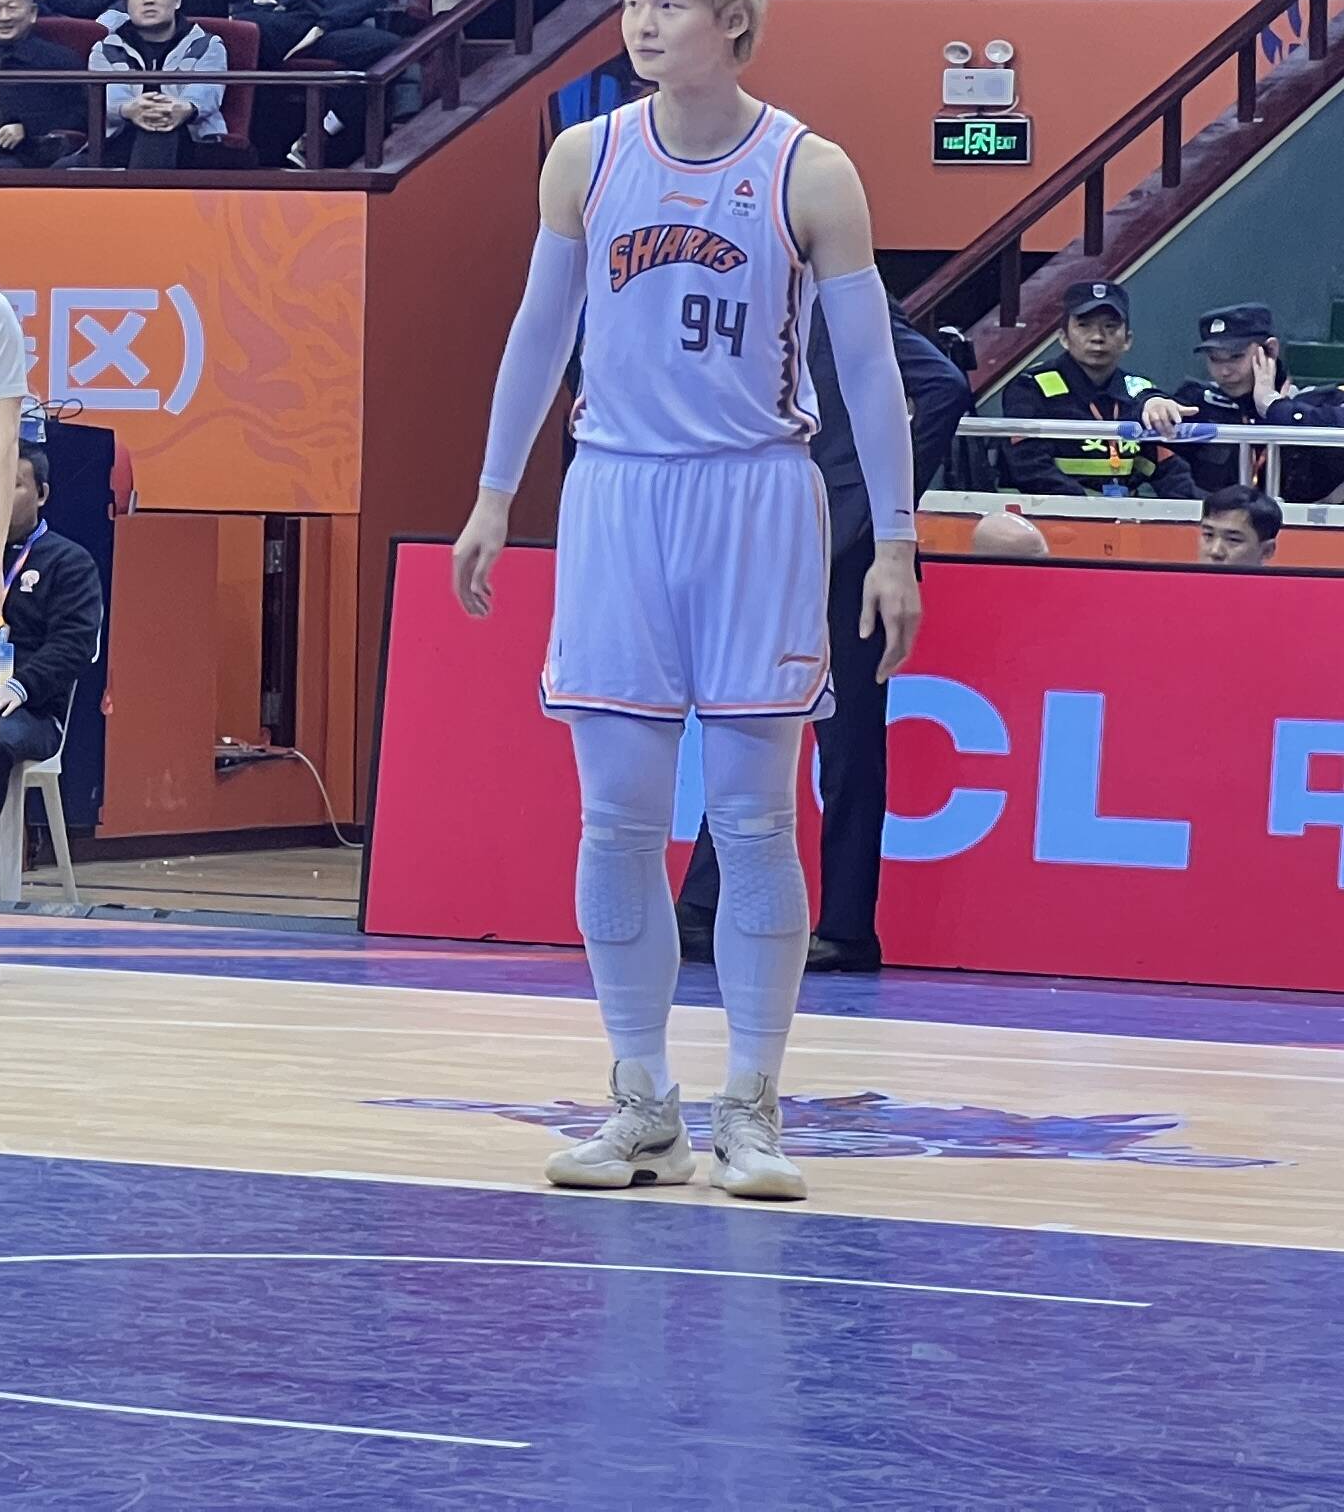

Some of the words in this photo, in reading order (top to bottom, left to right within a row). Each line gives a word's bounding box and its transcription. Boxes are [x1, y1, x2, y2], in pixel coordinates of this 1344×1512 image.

[996, 136, 1017, 150] EXIT
[609, 223, 748, 293] SHARKS
[680, 293, 750, 358] 94
[672, 675, 1192, 870] CL
